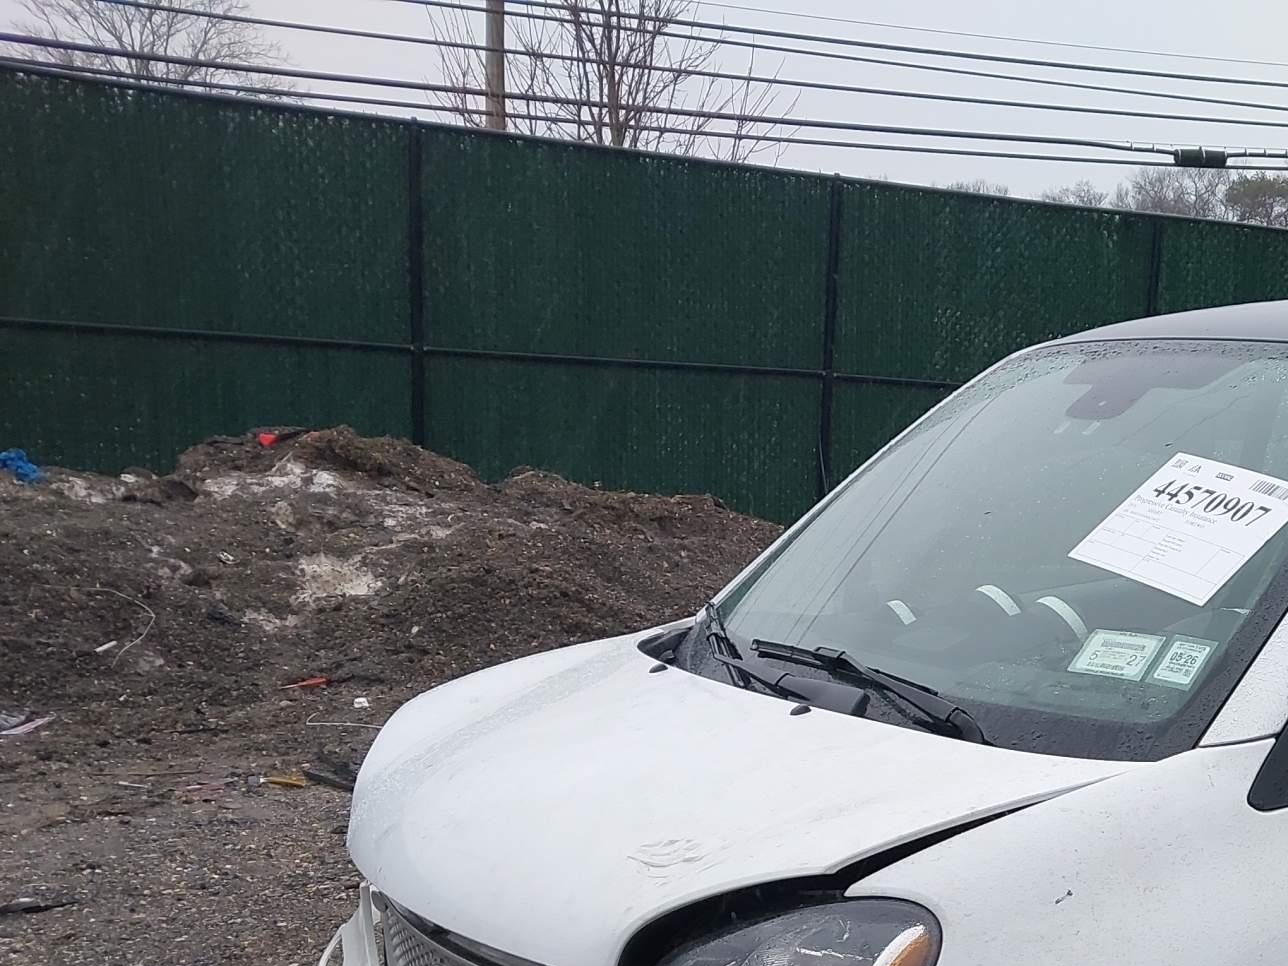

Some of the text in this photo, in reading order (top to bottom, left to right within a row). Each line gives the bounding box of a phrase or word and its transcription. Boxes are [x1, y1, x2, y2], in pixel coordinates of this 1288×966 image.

[1153, 479, 1272, 527] 44570907
[1088, 650, 1100, 661] 5
[1126, 654, 1147, 667] 27
